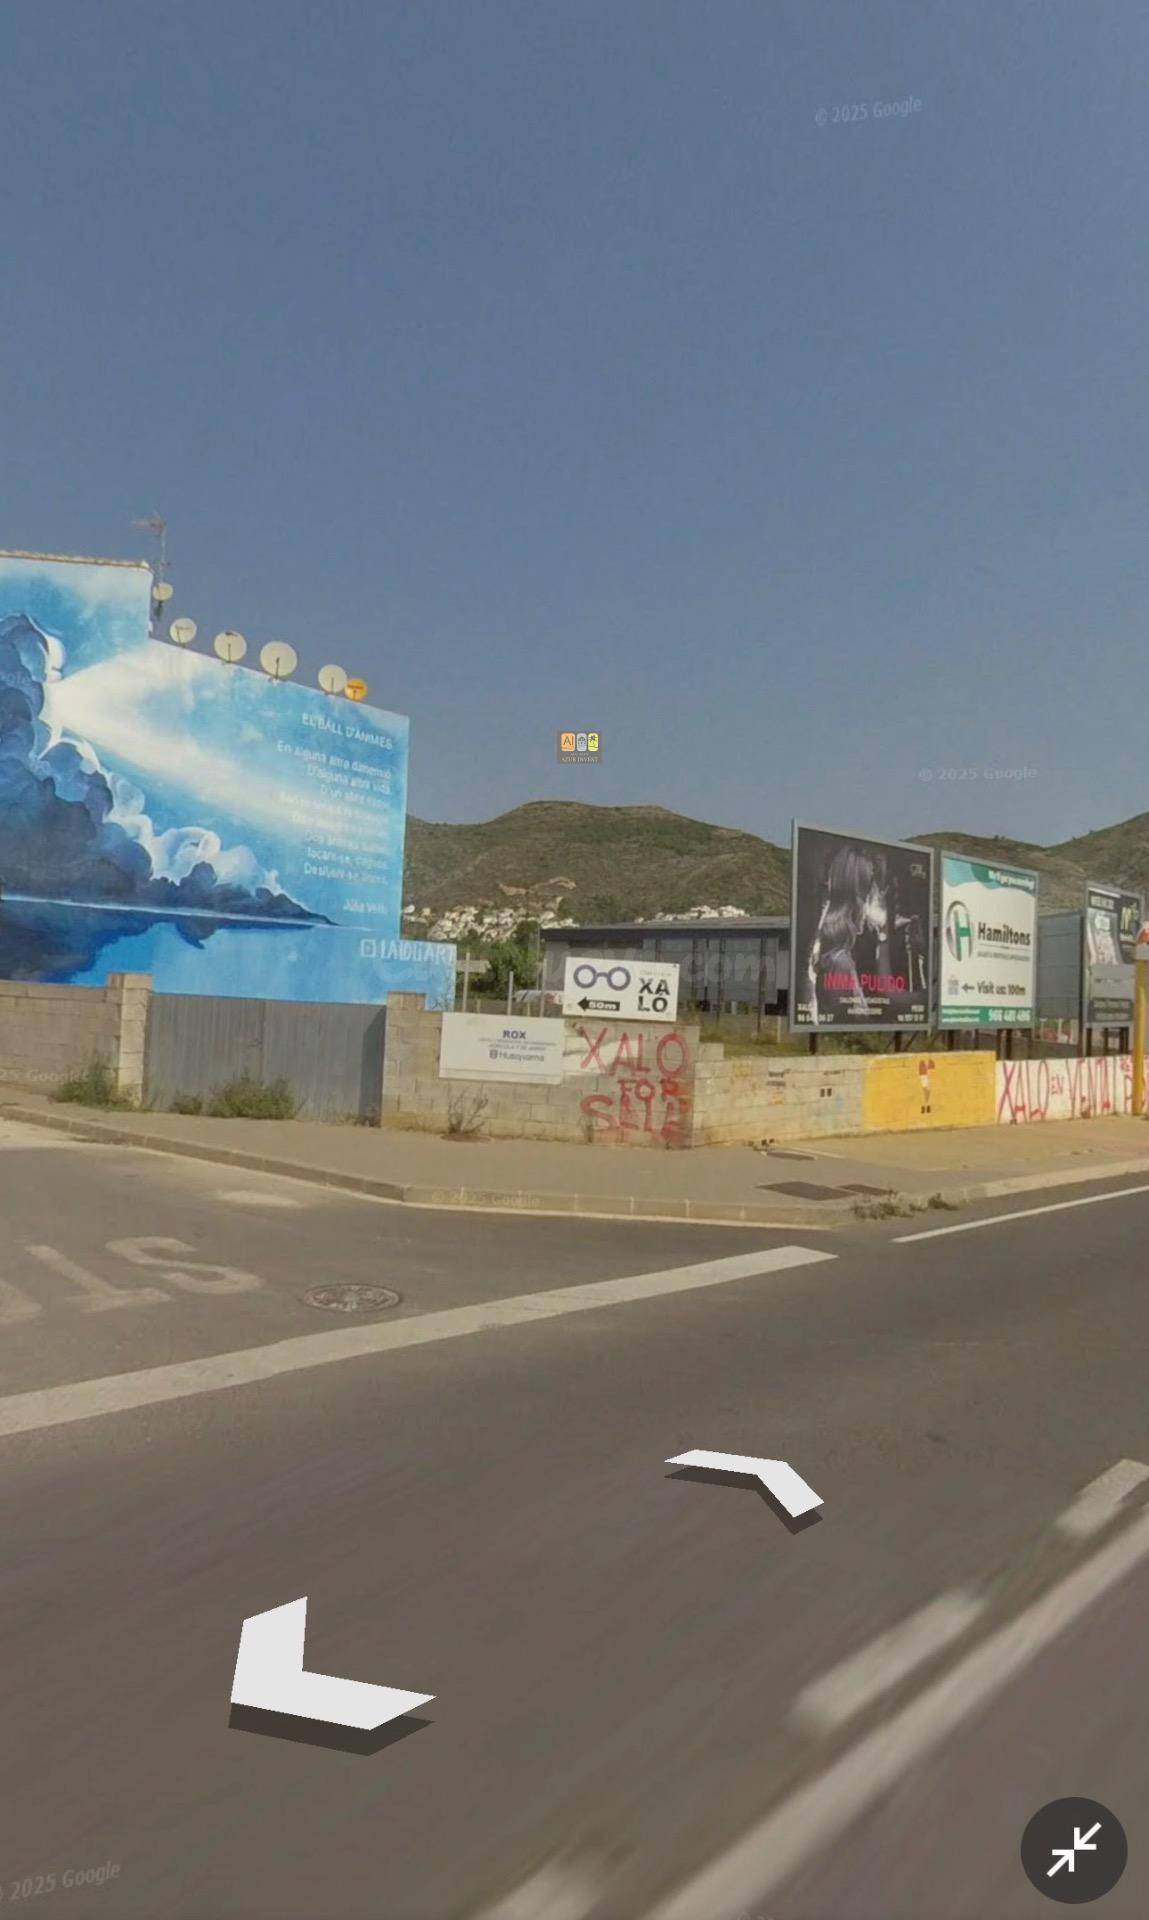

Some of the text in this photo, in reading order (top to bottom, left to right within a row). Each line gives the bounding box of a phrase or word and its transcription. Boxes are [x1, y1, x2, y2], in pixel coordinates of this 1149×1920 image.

[977, 921, 1031, 946] Hamiltons
[639, 978, 671, 996] XA
[976, 980, 994, 994] Visit
[503, 1029, 527, 1040] ROX
[499, 1050, 545, 1062] Husqvarna
